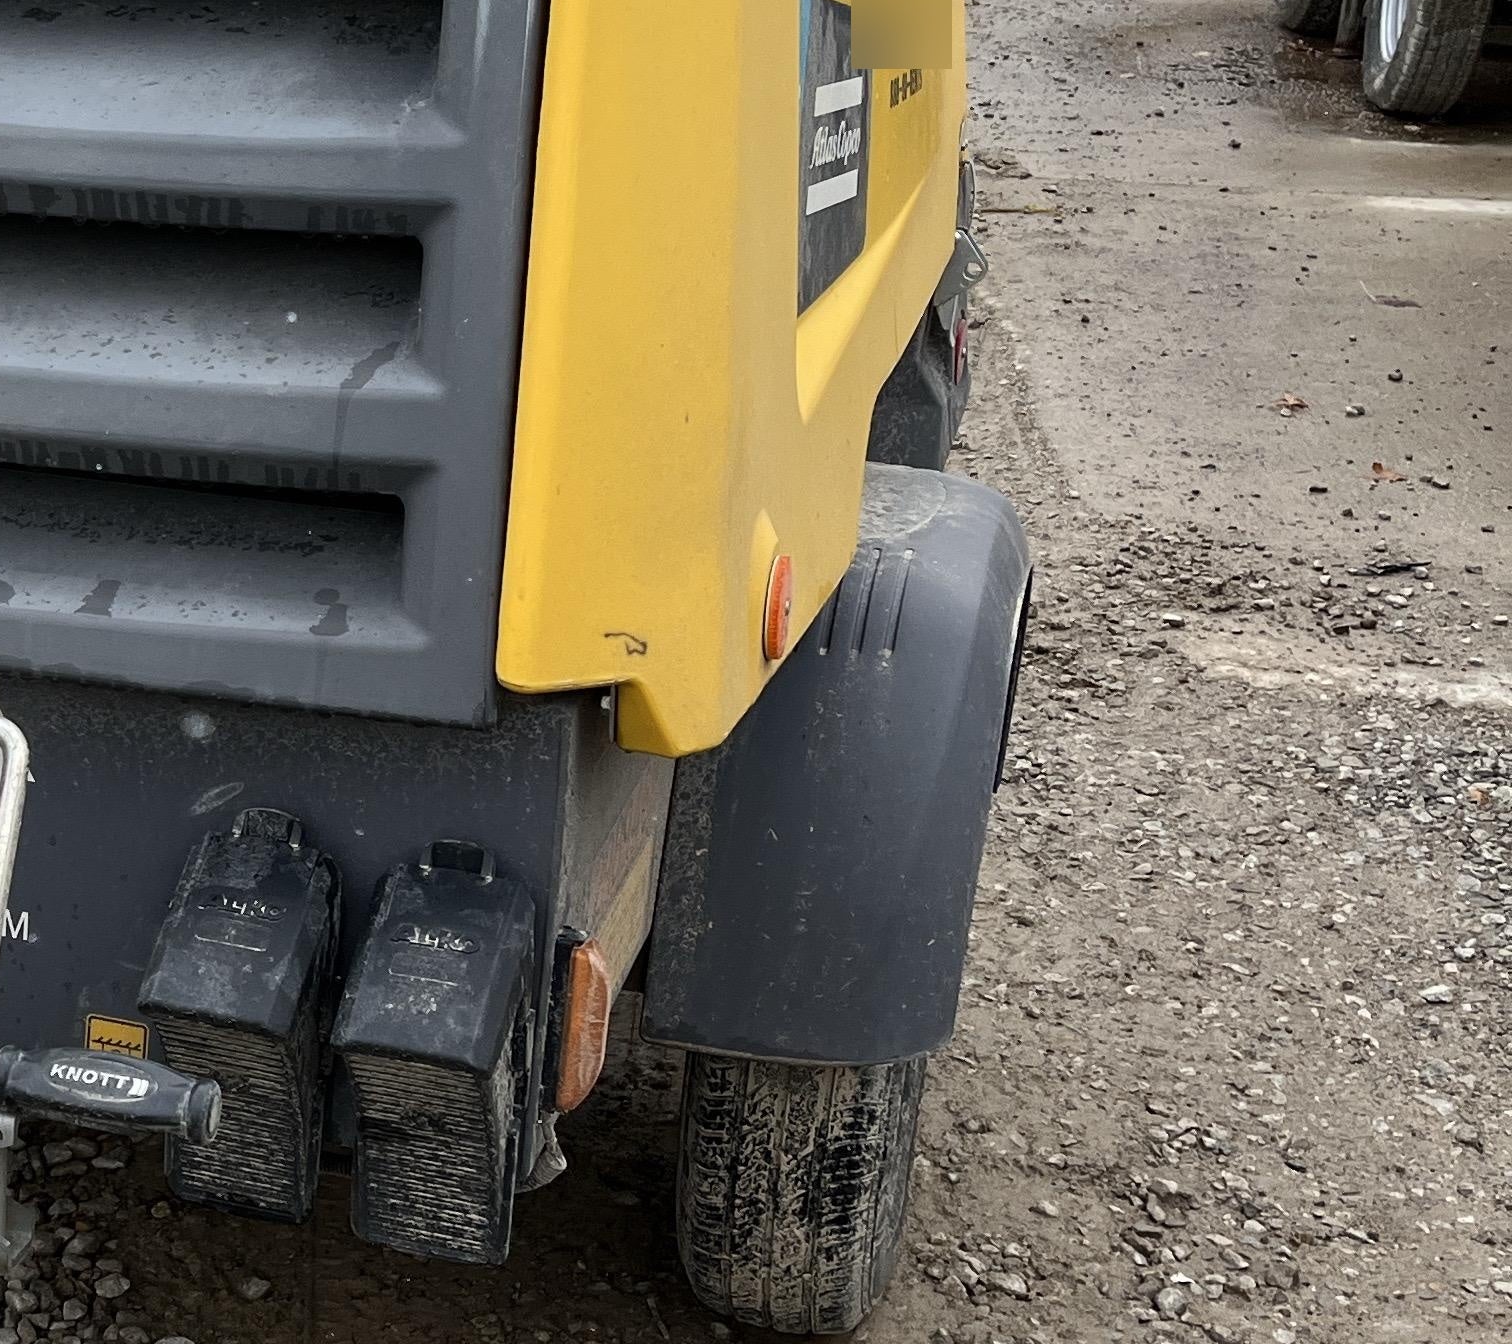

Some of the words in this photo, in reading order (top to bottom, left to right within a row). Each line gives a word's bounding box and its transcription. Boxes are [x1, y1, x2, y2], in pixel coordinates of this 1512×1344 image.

[809, 126, 838, 169] Atlas
[838, 120, 861, 166] Copco
[50, 1063, 130, 1089] KNOTT
